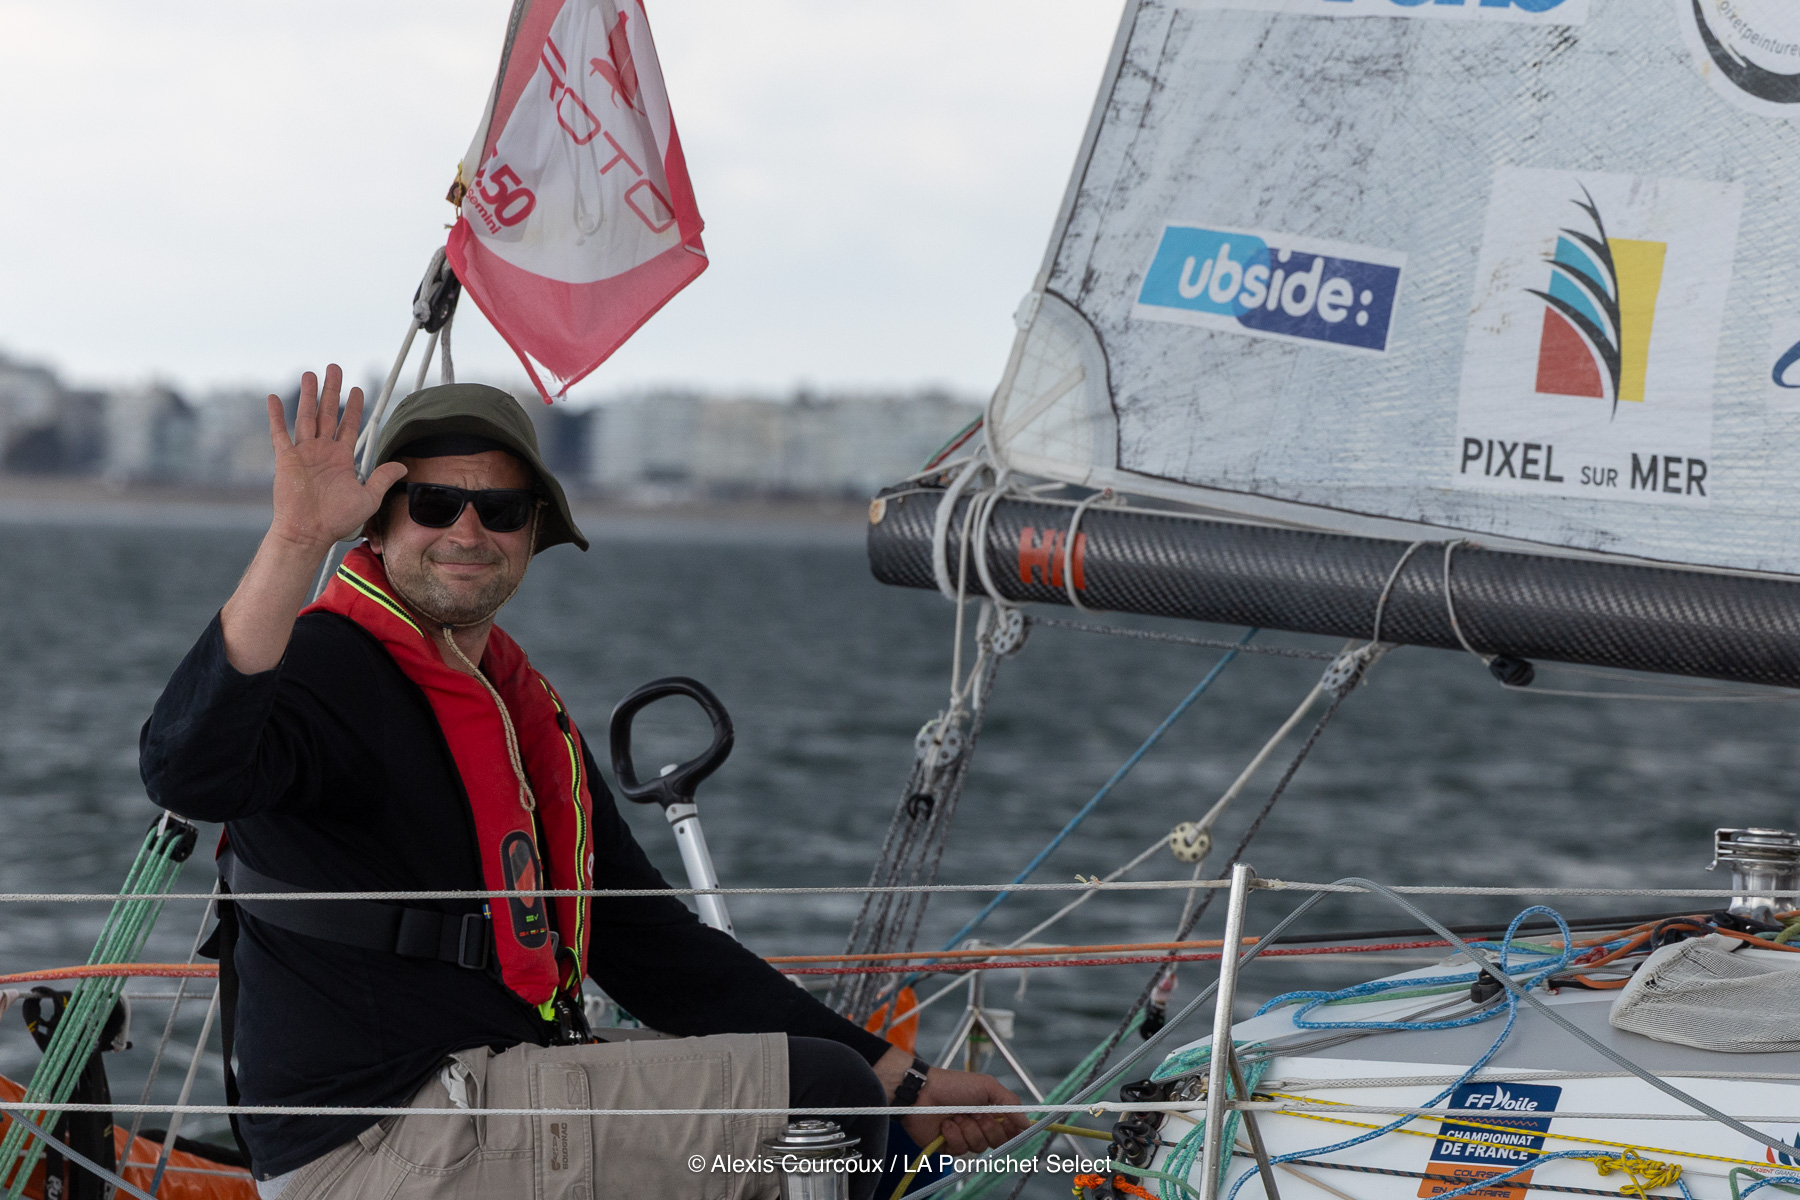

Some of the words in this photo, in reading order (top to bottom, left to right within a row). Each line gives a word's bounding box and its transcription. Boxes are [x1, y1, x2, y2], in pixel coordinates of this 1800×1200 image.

[476, 147, 536, 227] .50
[1461, 437, 1564, 483] PIXEL
[1580, 466, 1618, 487] SUR
[1630, 452, 1708, 496] MER
[1447, 1130, 1534, 1146] CHAMPIONNAT
[1440, 1141, 1464, 1156] DE
[1464, 1143, 1529, 1161] FRANCE
[1452, 1187, 1511, 1198] LITAIRE
